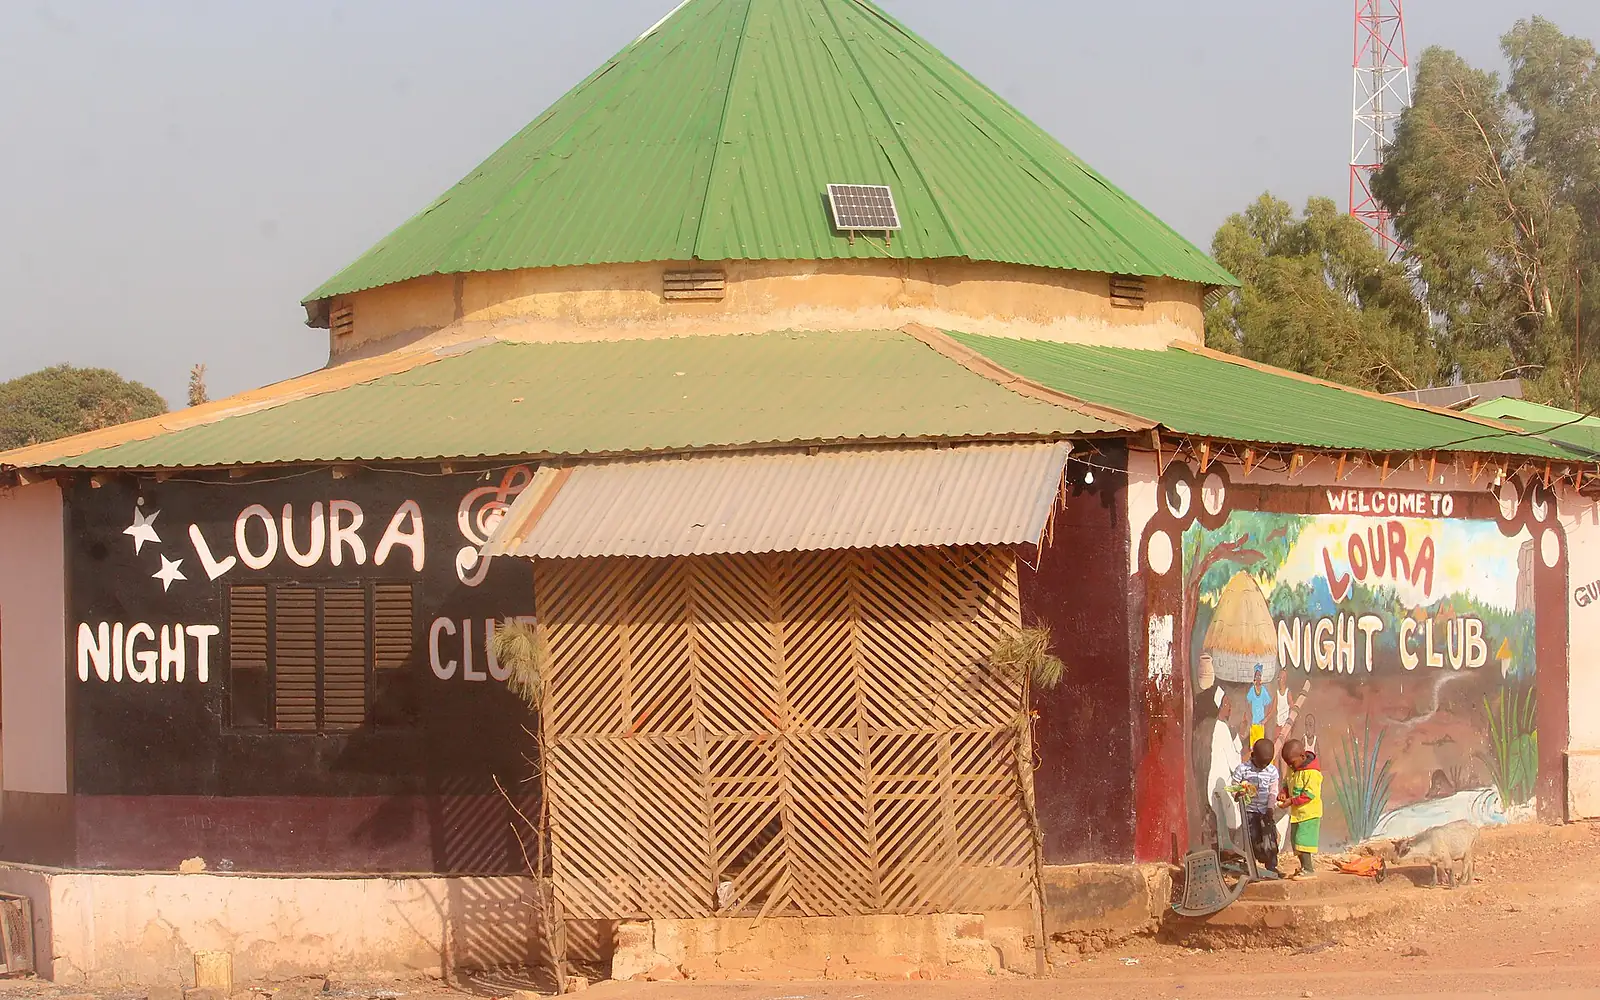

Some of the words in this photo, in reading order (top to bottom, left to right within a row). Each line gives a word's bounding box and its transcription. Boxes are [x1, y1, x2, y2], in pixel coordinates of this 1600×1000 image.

[1326, 489, 1426, 514] WELCOME
[1430, 492, 1454, 517] TO
[188, 499, 425, 581] LOURA
[1322, 520, 1435, 603] LOURA
[77, 621, 220, 683] NIGHT
[1277, 612, 1384, 675] NIGHT
[1399, 616, 1488, 670] CLUB
